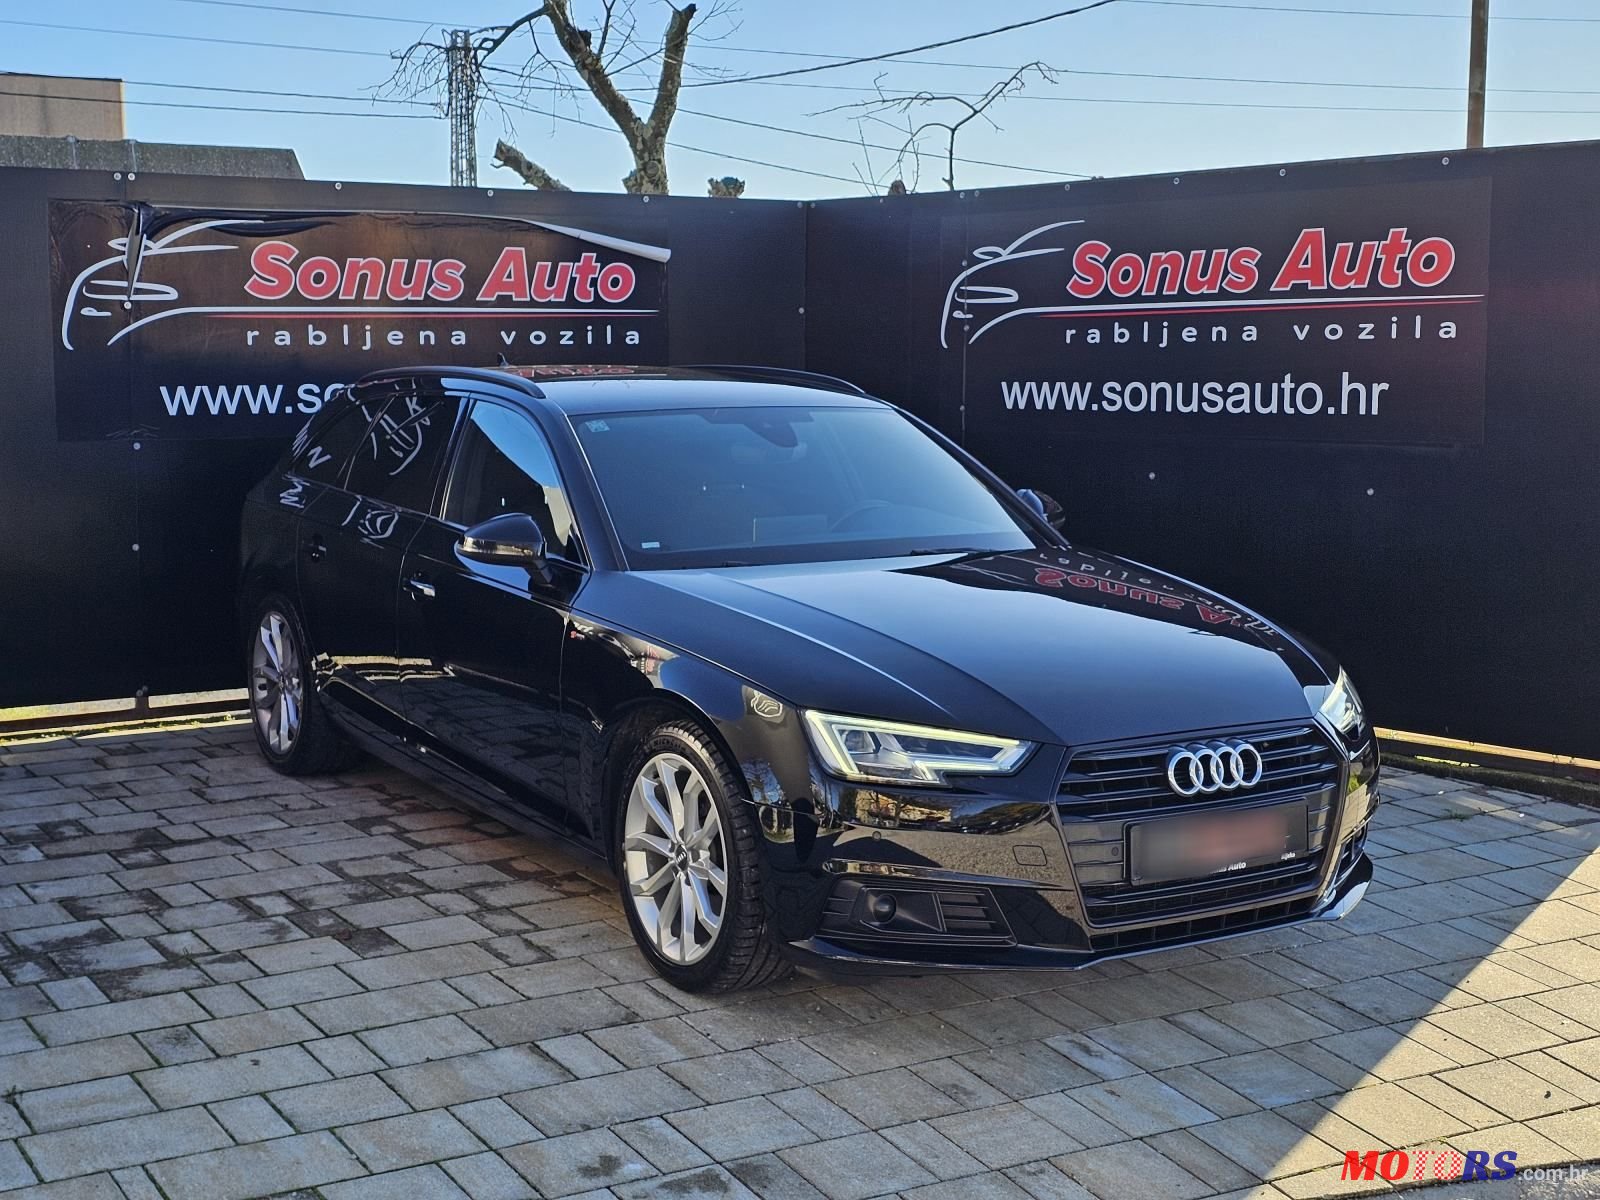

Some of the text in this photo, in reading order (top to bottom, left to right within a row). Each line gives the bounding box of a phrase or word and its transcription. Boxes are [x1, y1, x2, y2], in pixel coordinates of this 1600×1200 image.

[243, 241, 636, 303] Sonus Auto
[1066, 228, 1455, 298] Sonus Auto
[247, 324, 639, 349] rabljena vozila
[1066, 316, 1456, 347] rabljena vozila
[1001, 372, 1389, 416] www.sonusauto.hr
